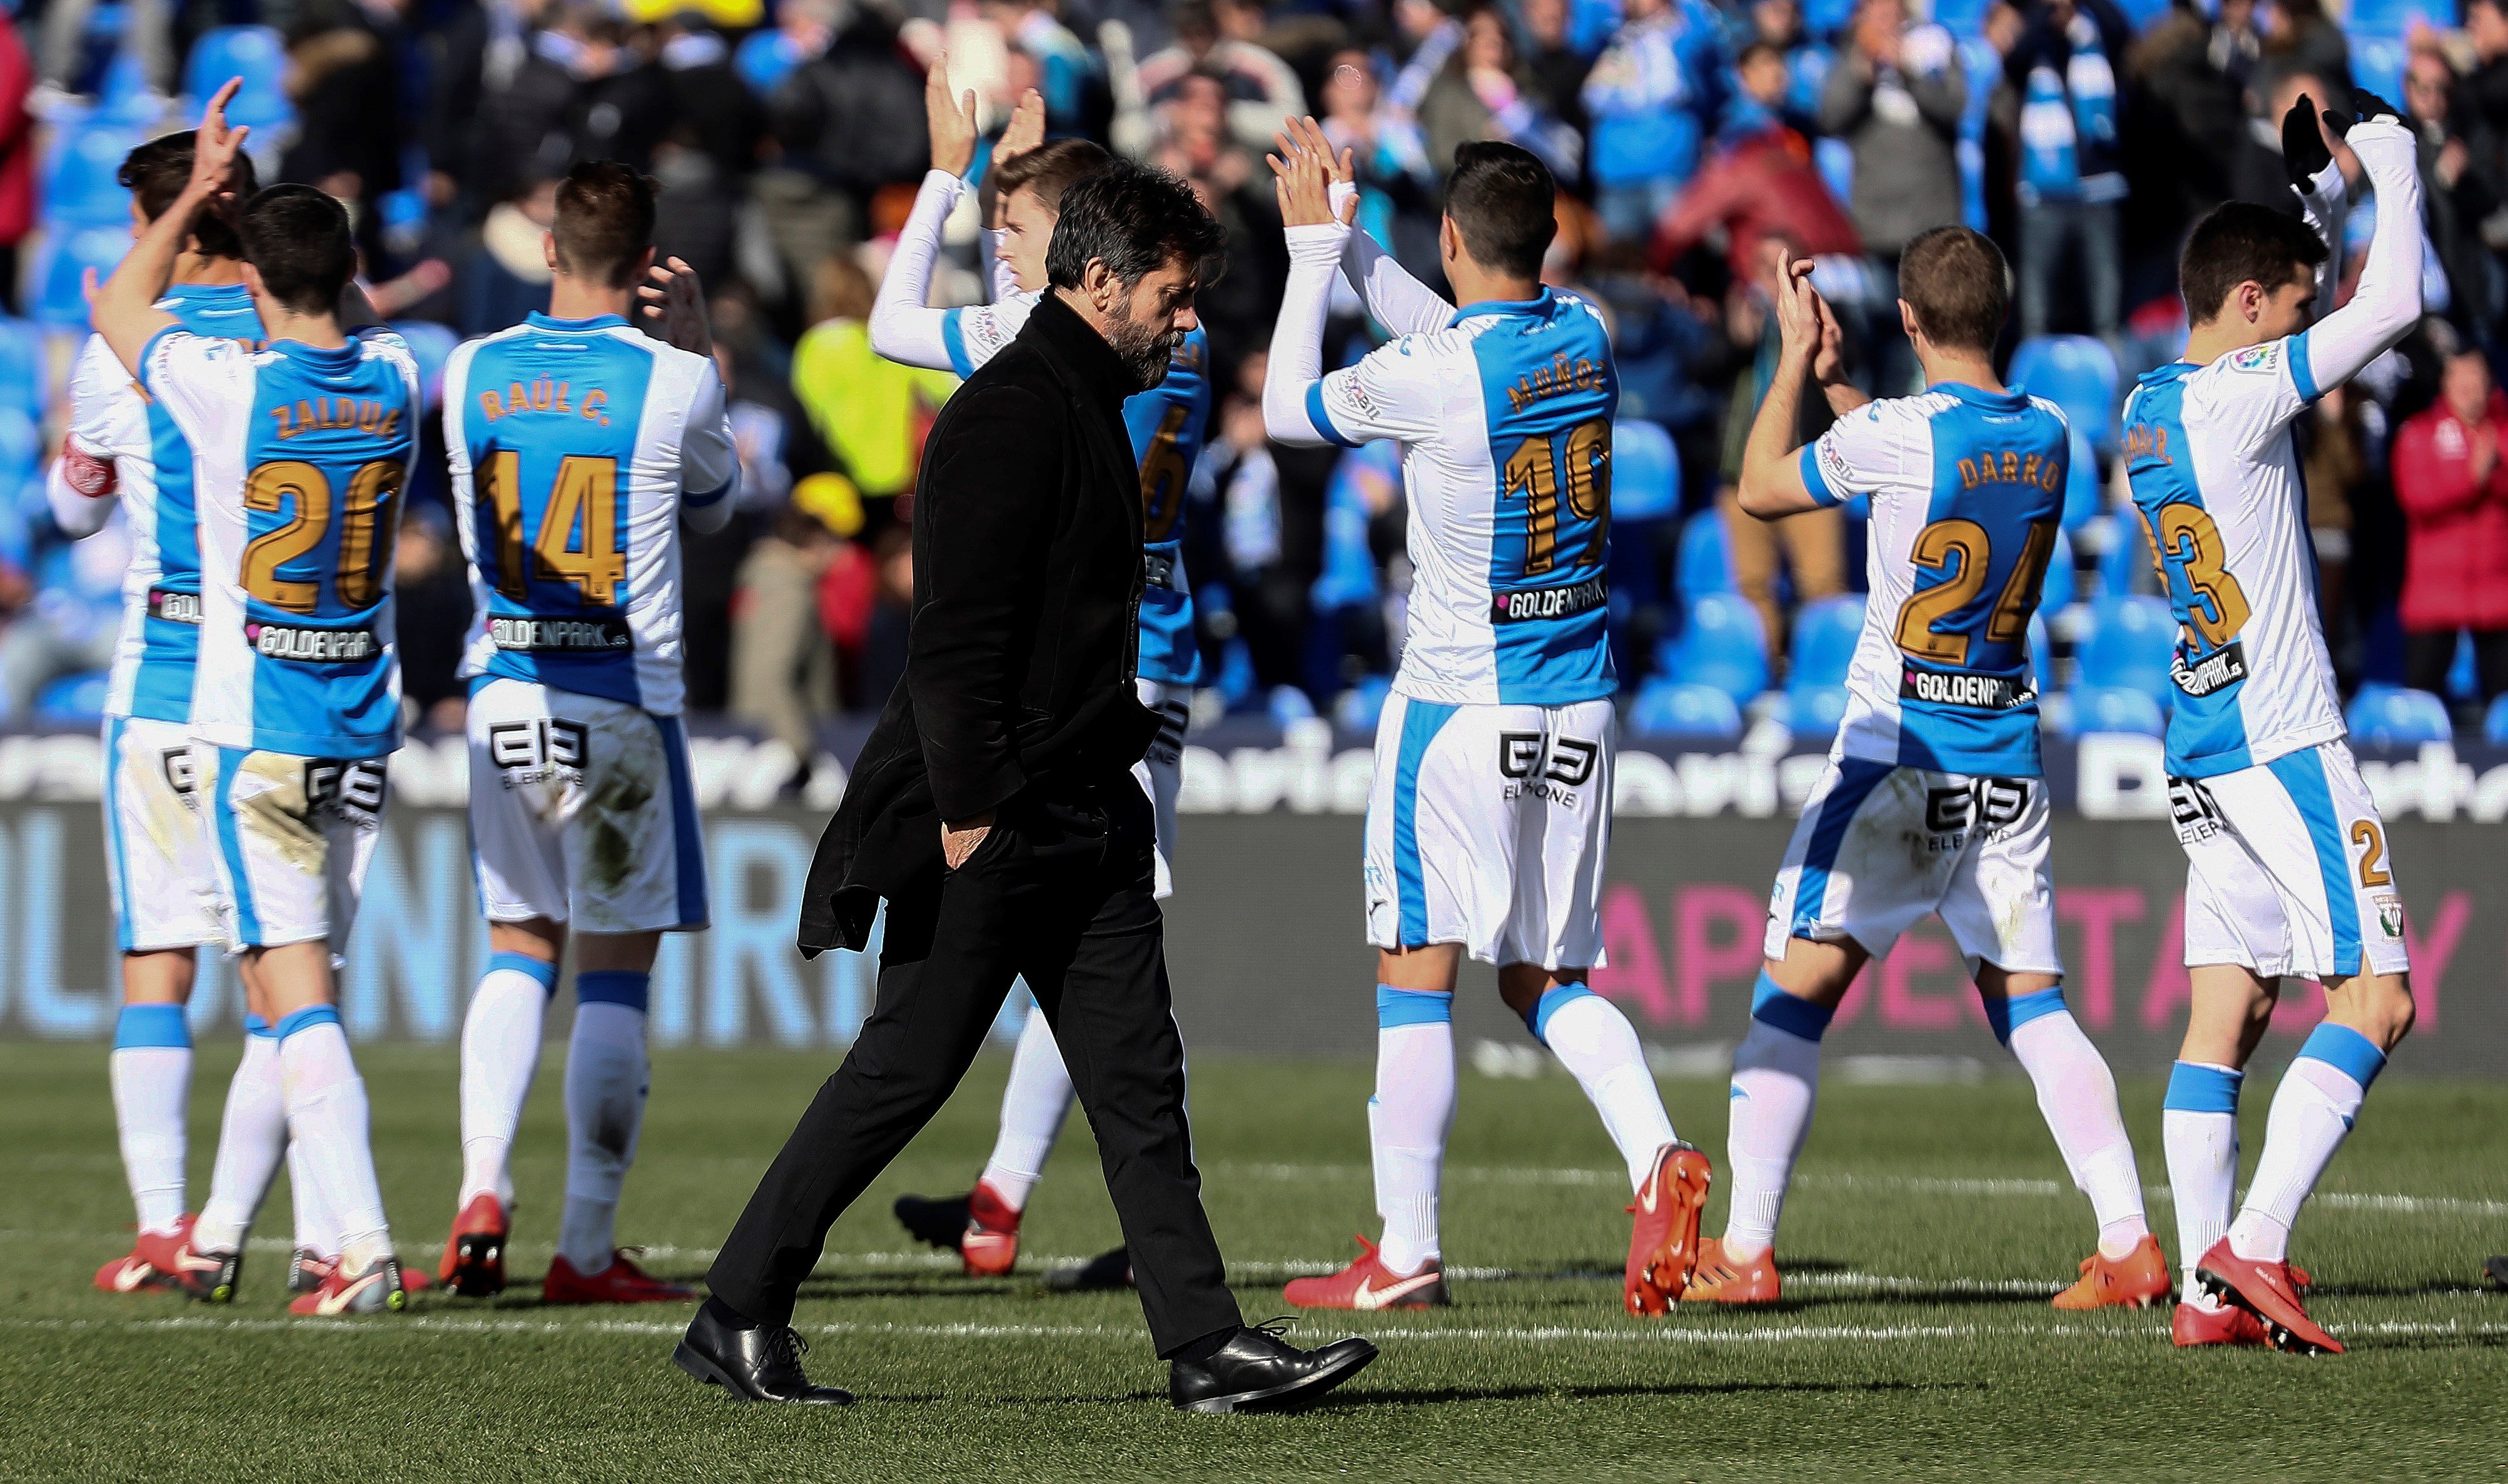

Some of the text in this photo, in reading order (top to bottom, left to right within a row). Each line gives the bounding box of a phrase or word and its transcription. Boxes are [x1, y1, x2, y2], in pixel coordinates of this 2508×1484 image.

[479, 371, 610, 427] RAÚL C.
[1956, 450, 2060, 493] DARKO
[240, 460, 405, 614] 20
[474, 450, 627, 608] 14
[1502, 418, 1612, 577] 19
[1893, 519, 2060, 665] 24
[2139, 502, 2253, 654] 3
